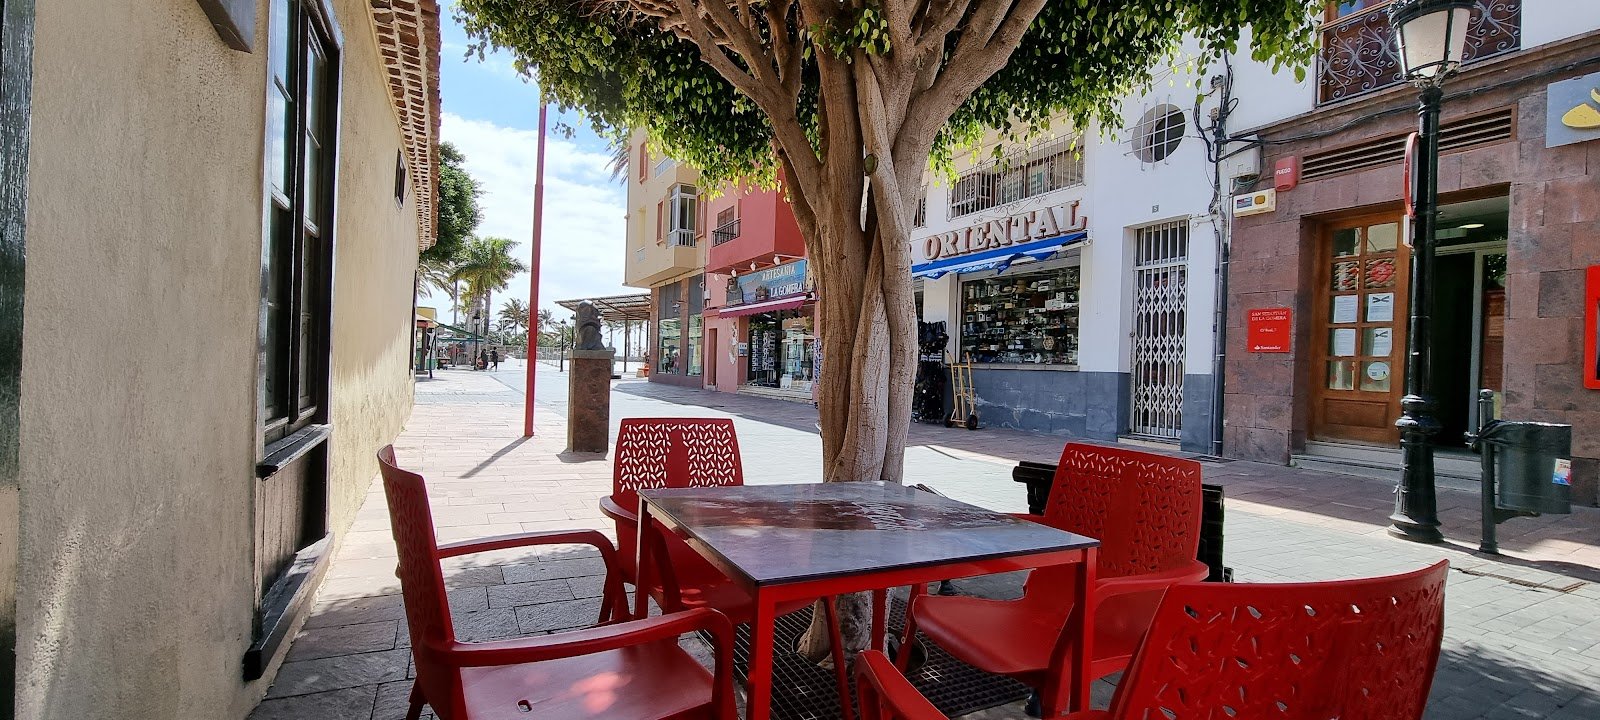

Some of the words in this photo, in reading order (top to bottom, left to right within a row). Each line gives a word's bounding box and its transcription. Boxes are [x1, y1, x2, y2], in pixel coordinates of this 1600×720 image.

[922, 200, 1087, 260] ORIENTAL
[770, 288, 778, 298] LA
[779, 282, 803, 296] GOMERA
